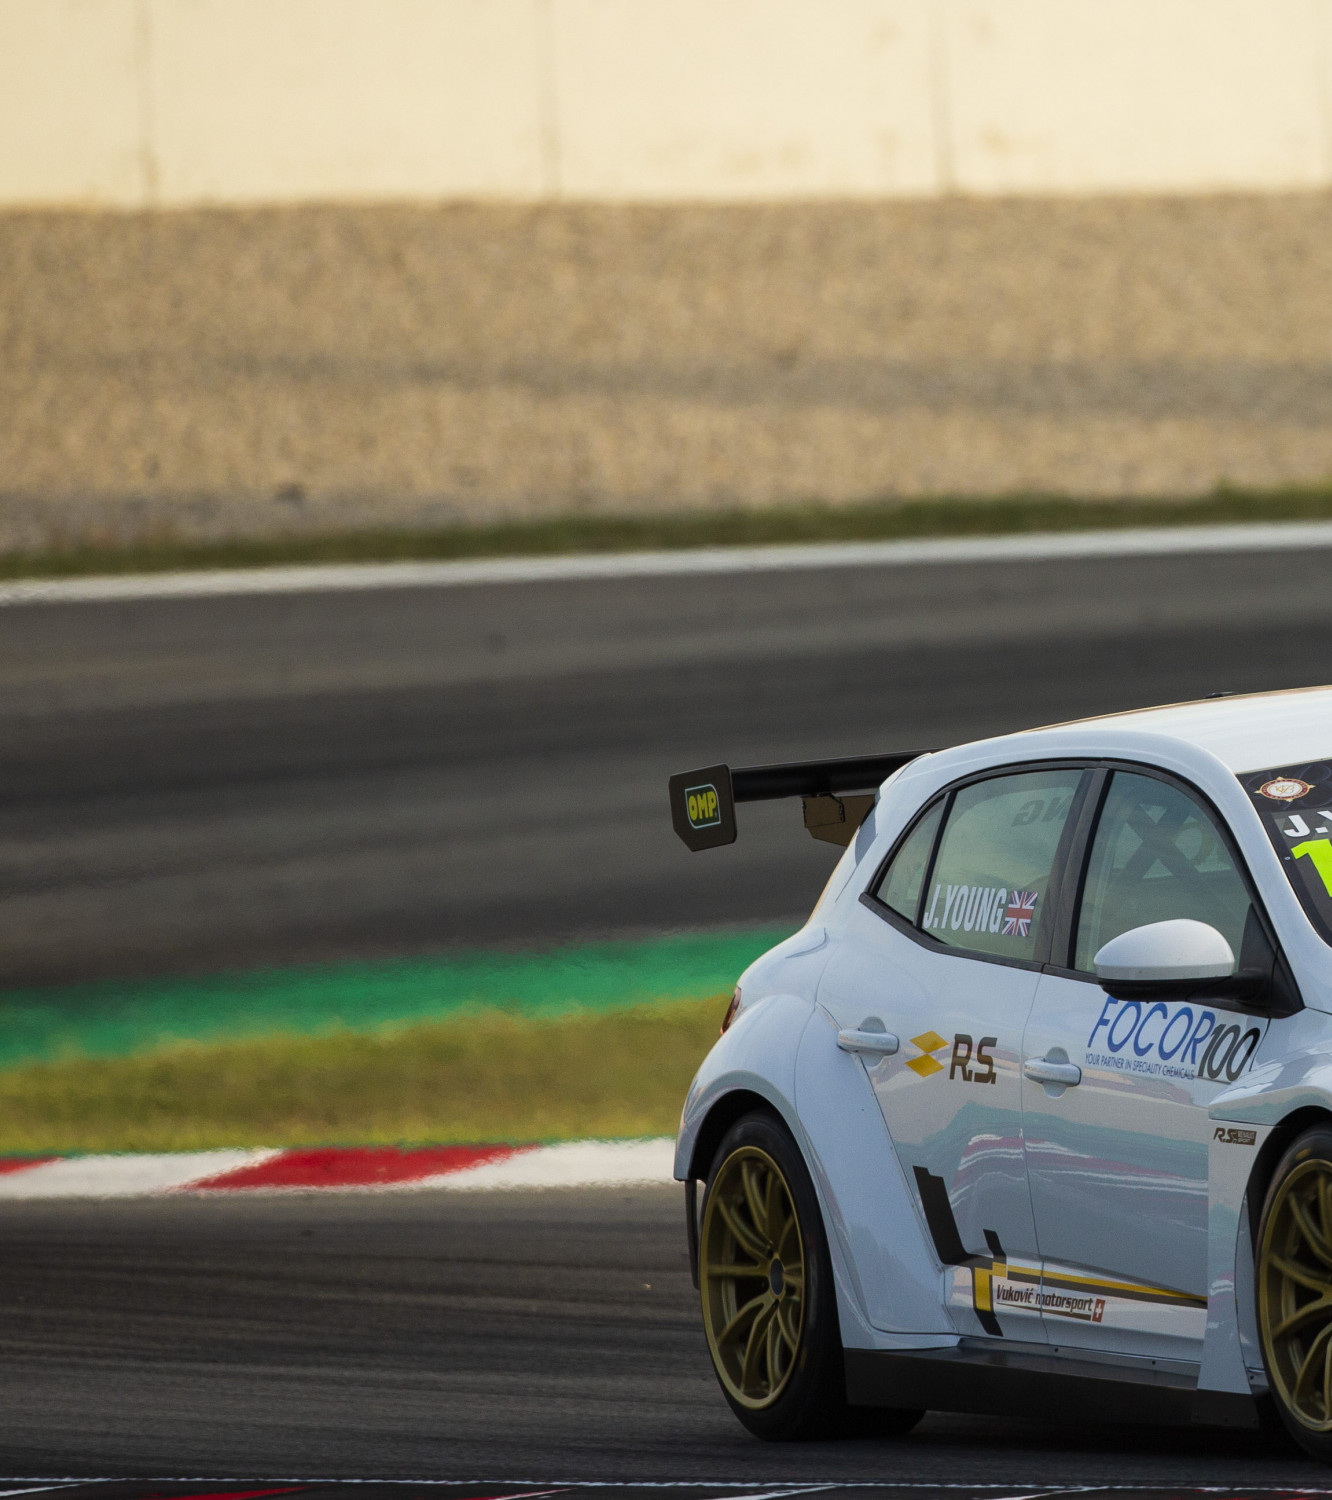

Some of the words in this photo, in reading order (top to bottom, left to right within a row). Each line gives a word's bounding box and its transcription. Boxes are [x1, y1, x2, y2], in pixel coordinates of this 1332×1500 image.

[688, 791, 717, 821] OMP
[923, 883, 1008, 934] J.YOUNG
[1085, 1053, 1101, 1066] YOUR
[1101, 1056, 1125, 1069] PARTNER
[1125, 1060, 1132, 1070] IN
[1132, 1061, 1162, 1074] SPECIALITY
[1162, 1065, 1195, 1081] CHEMICALS
[1197, 1023, 1260, 1081] 100
[996, 1284, 1034, 1304] Vuković
[1035, 1292, 1094, 1312] motorsport
